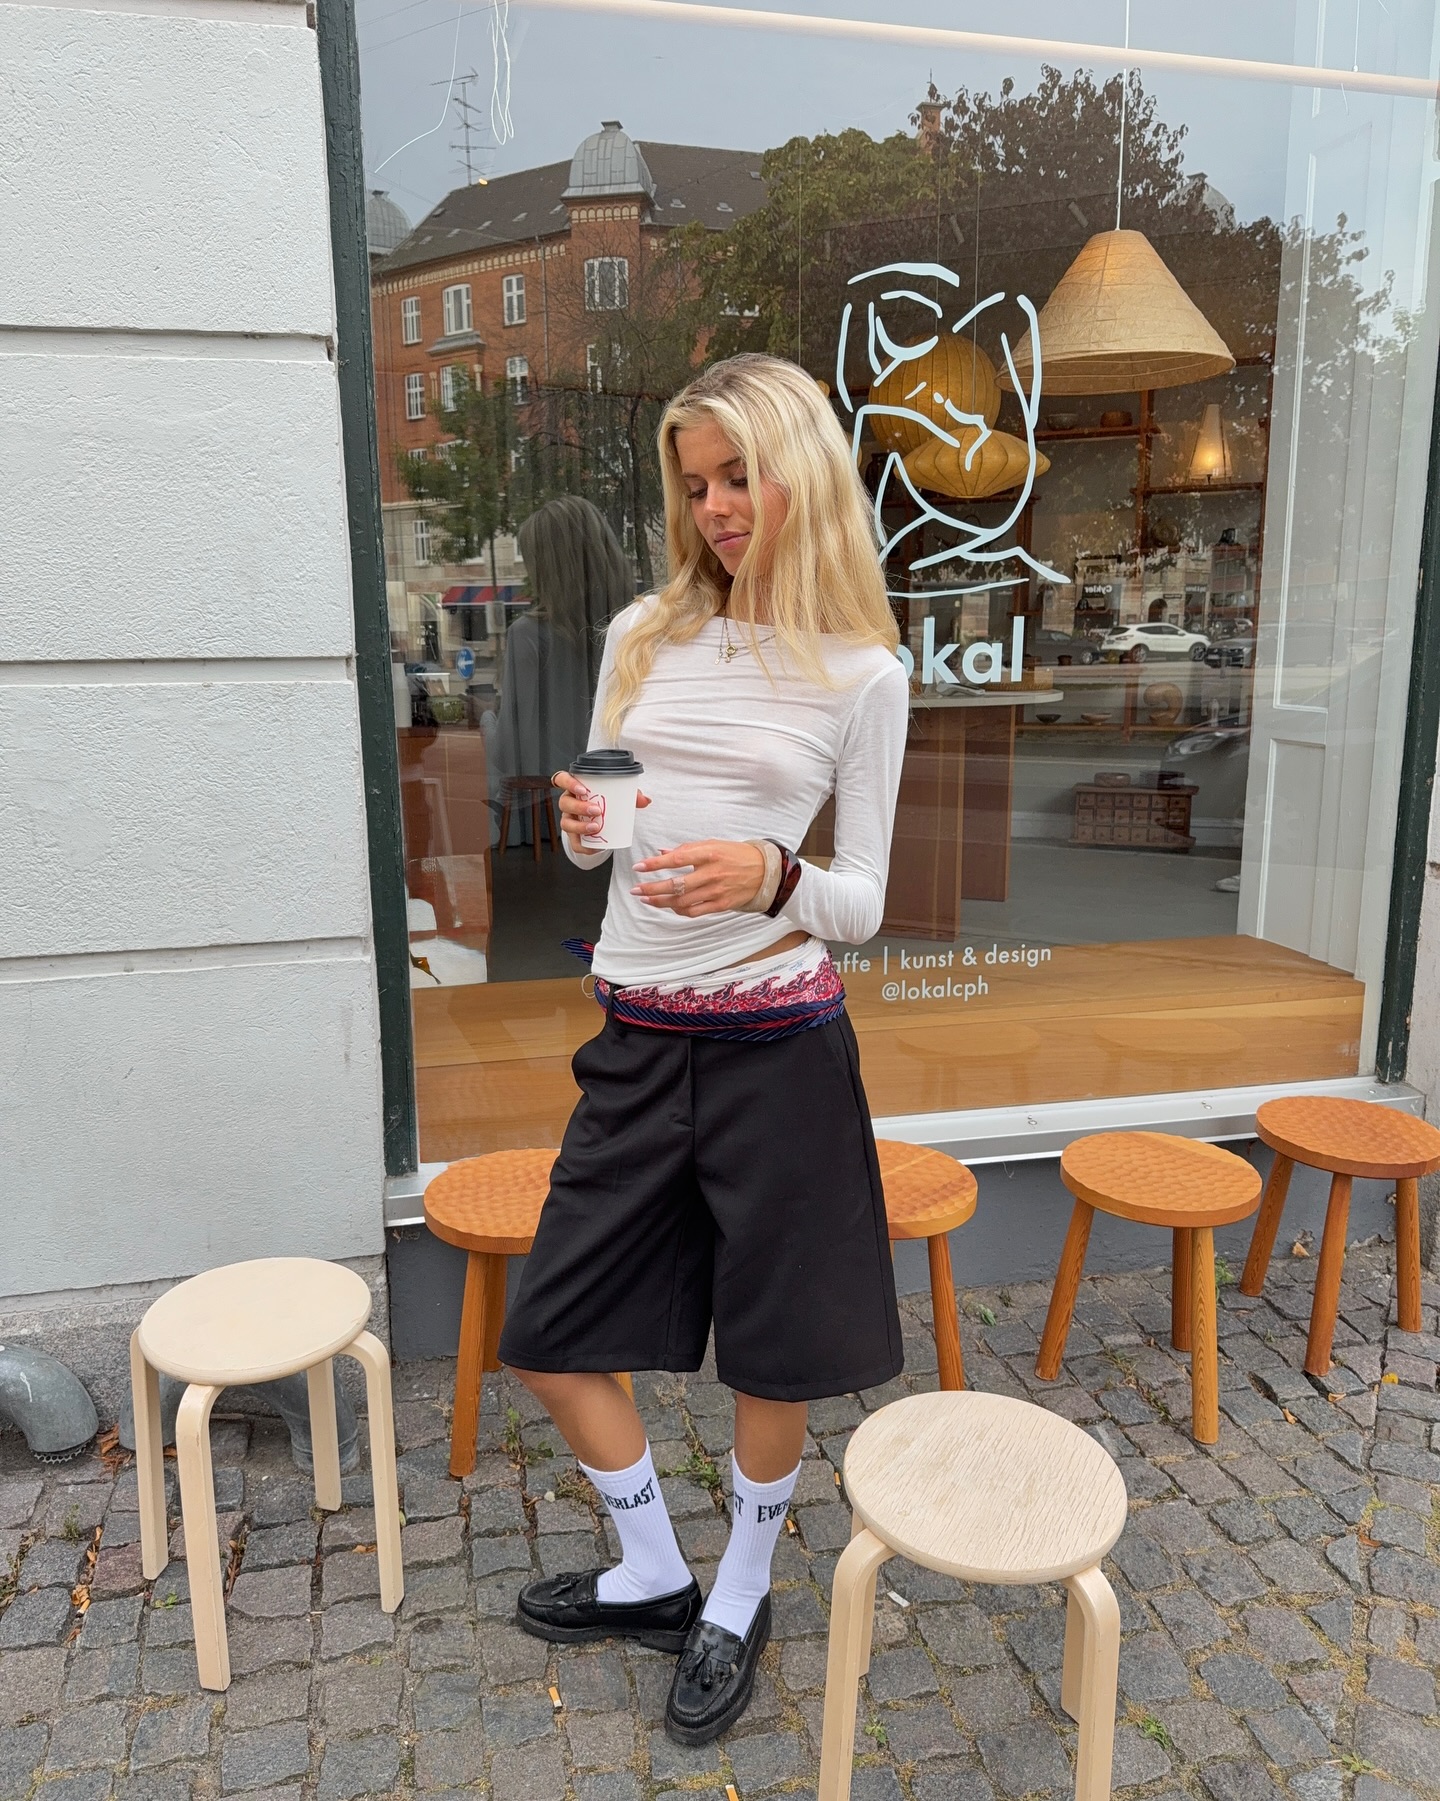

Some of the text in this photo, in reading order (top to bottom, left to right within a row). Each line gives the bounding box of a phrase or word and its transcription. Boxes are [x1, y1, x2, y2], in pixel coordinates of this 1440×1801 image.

[900, 949, 954, 970] kunst
[962, 946, 977, 966] &
[984, 943, 1051, 967] design
[881, 975, 989, 1001] @lokalcph
